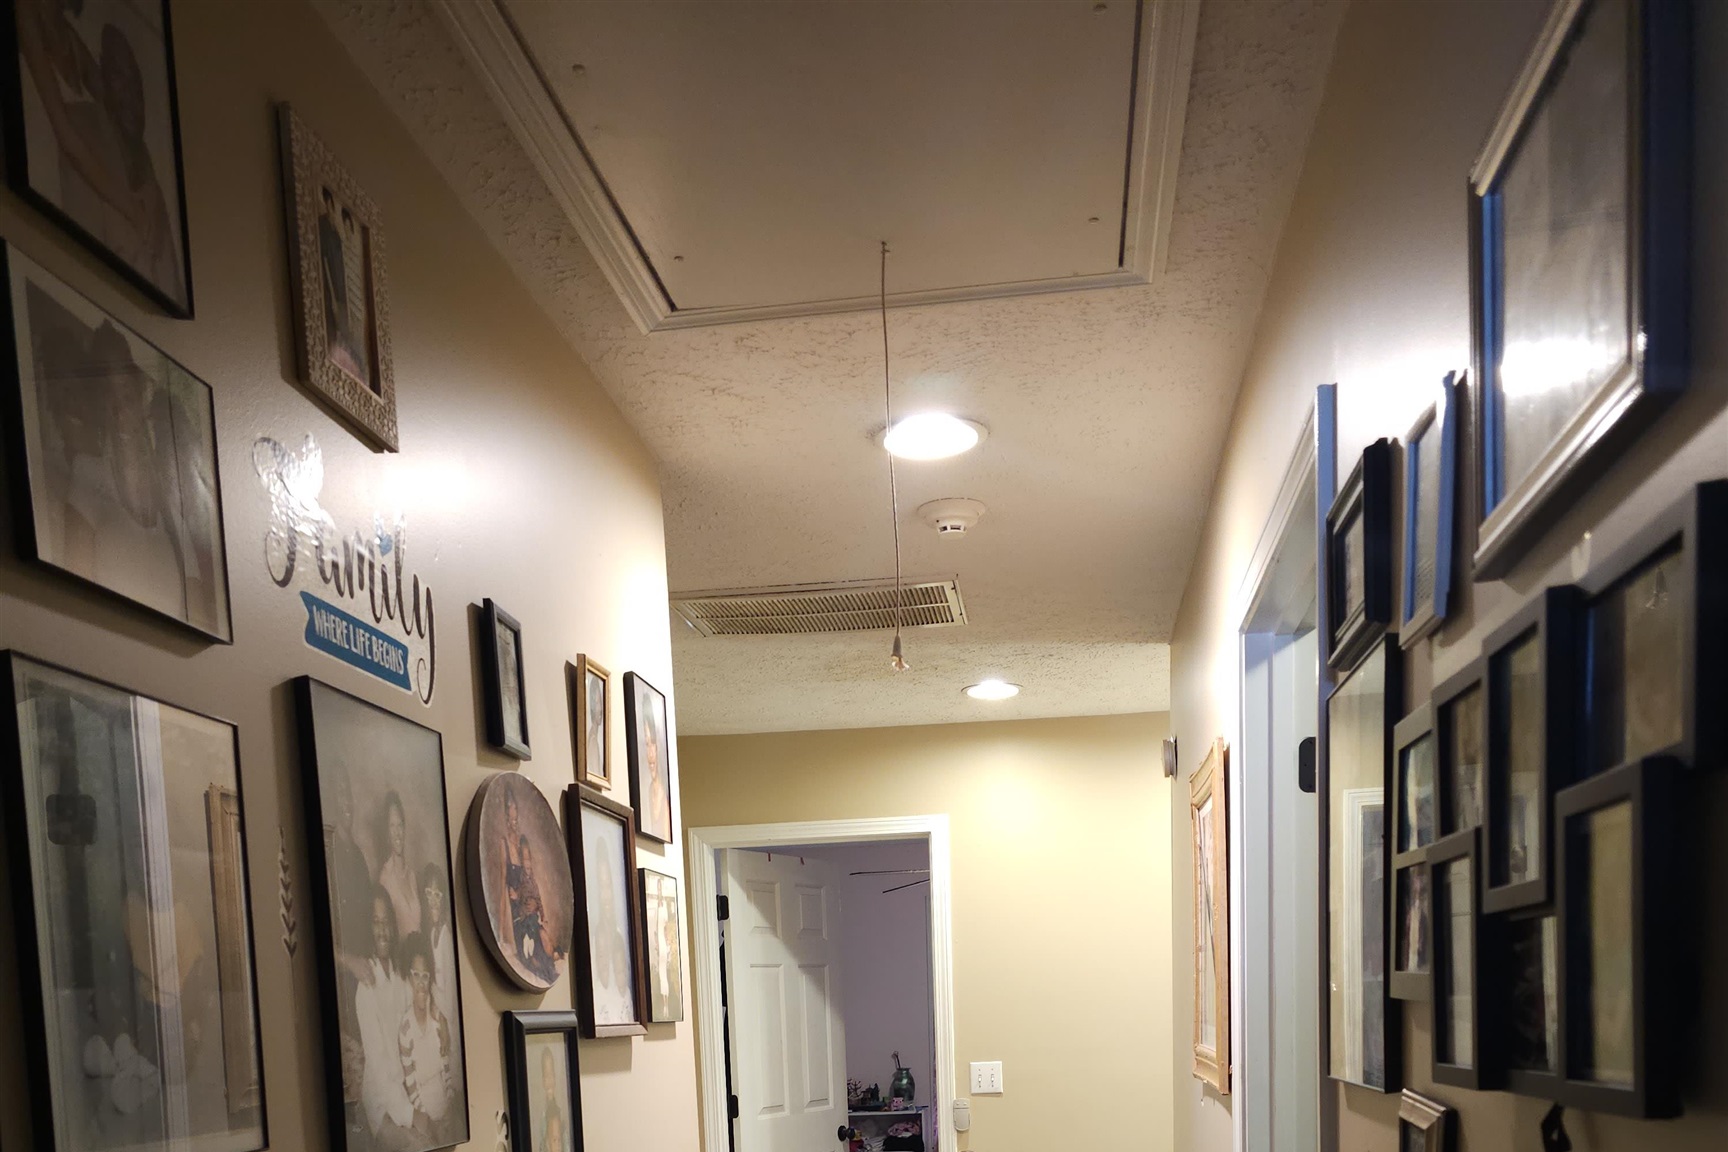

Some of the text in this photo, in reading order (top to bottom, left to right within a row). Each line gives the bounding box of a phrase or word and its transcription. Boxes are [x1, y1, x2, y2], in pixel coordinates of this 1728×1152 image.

[252, 434, 435, 705] Family
[313, 605, 404, 675] WHERE LIFE BEGINS
